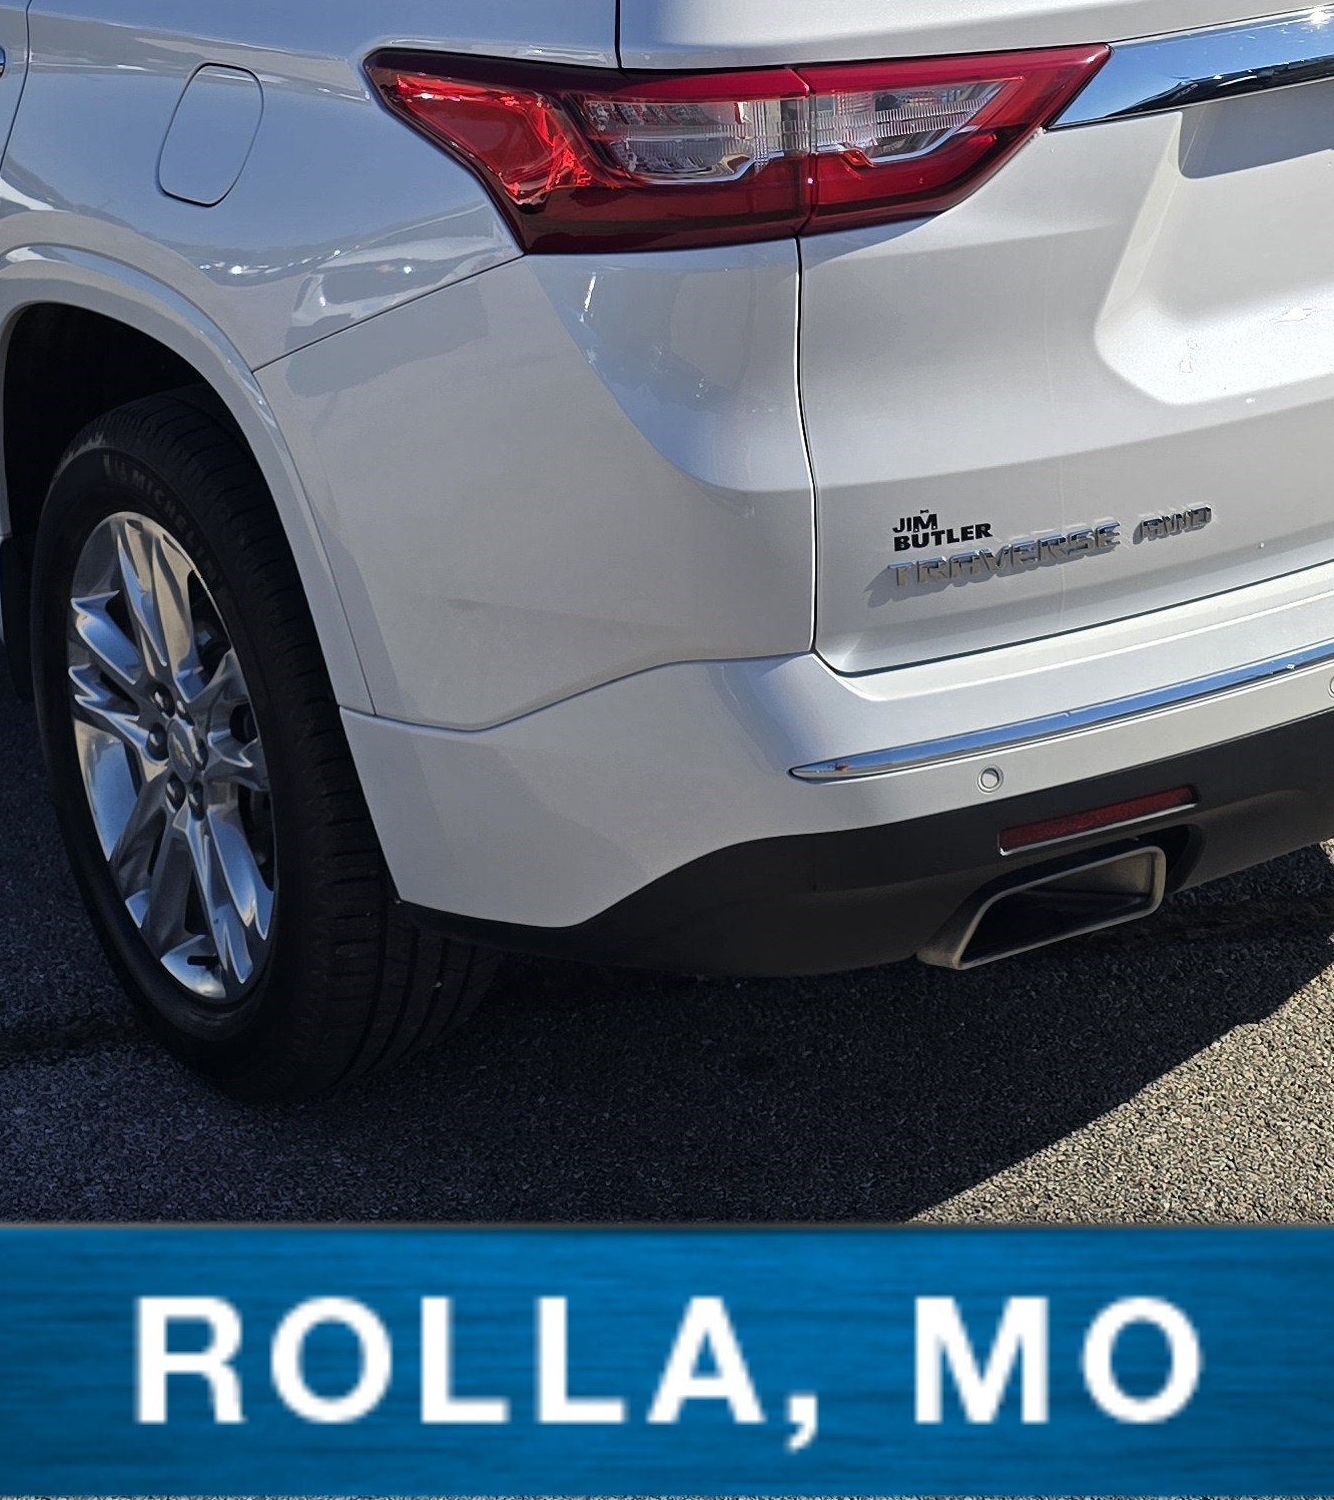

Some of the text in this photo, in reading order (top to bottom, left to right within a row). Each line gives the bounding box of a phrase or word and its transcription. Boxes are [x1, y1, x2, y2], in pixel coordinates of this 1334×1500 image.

[892, 512, 938, 534] JIM
[893, 522, 993, 551] BUTLER
[888, 504, 1213, 587] TRAVERSE AWD
